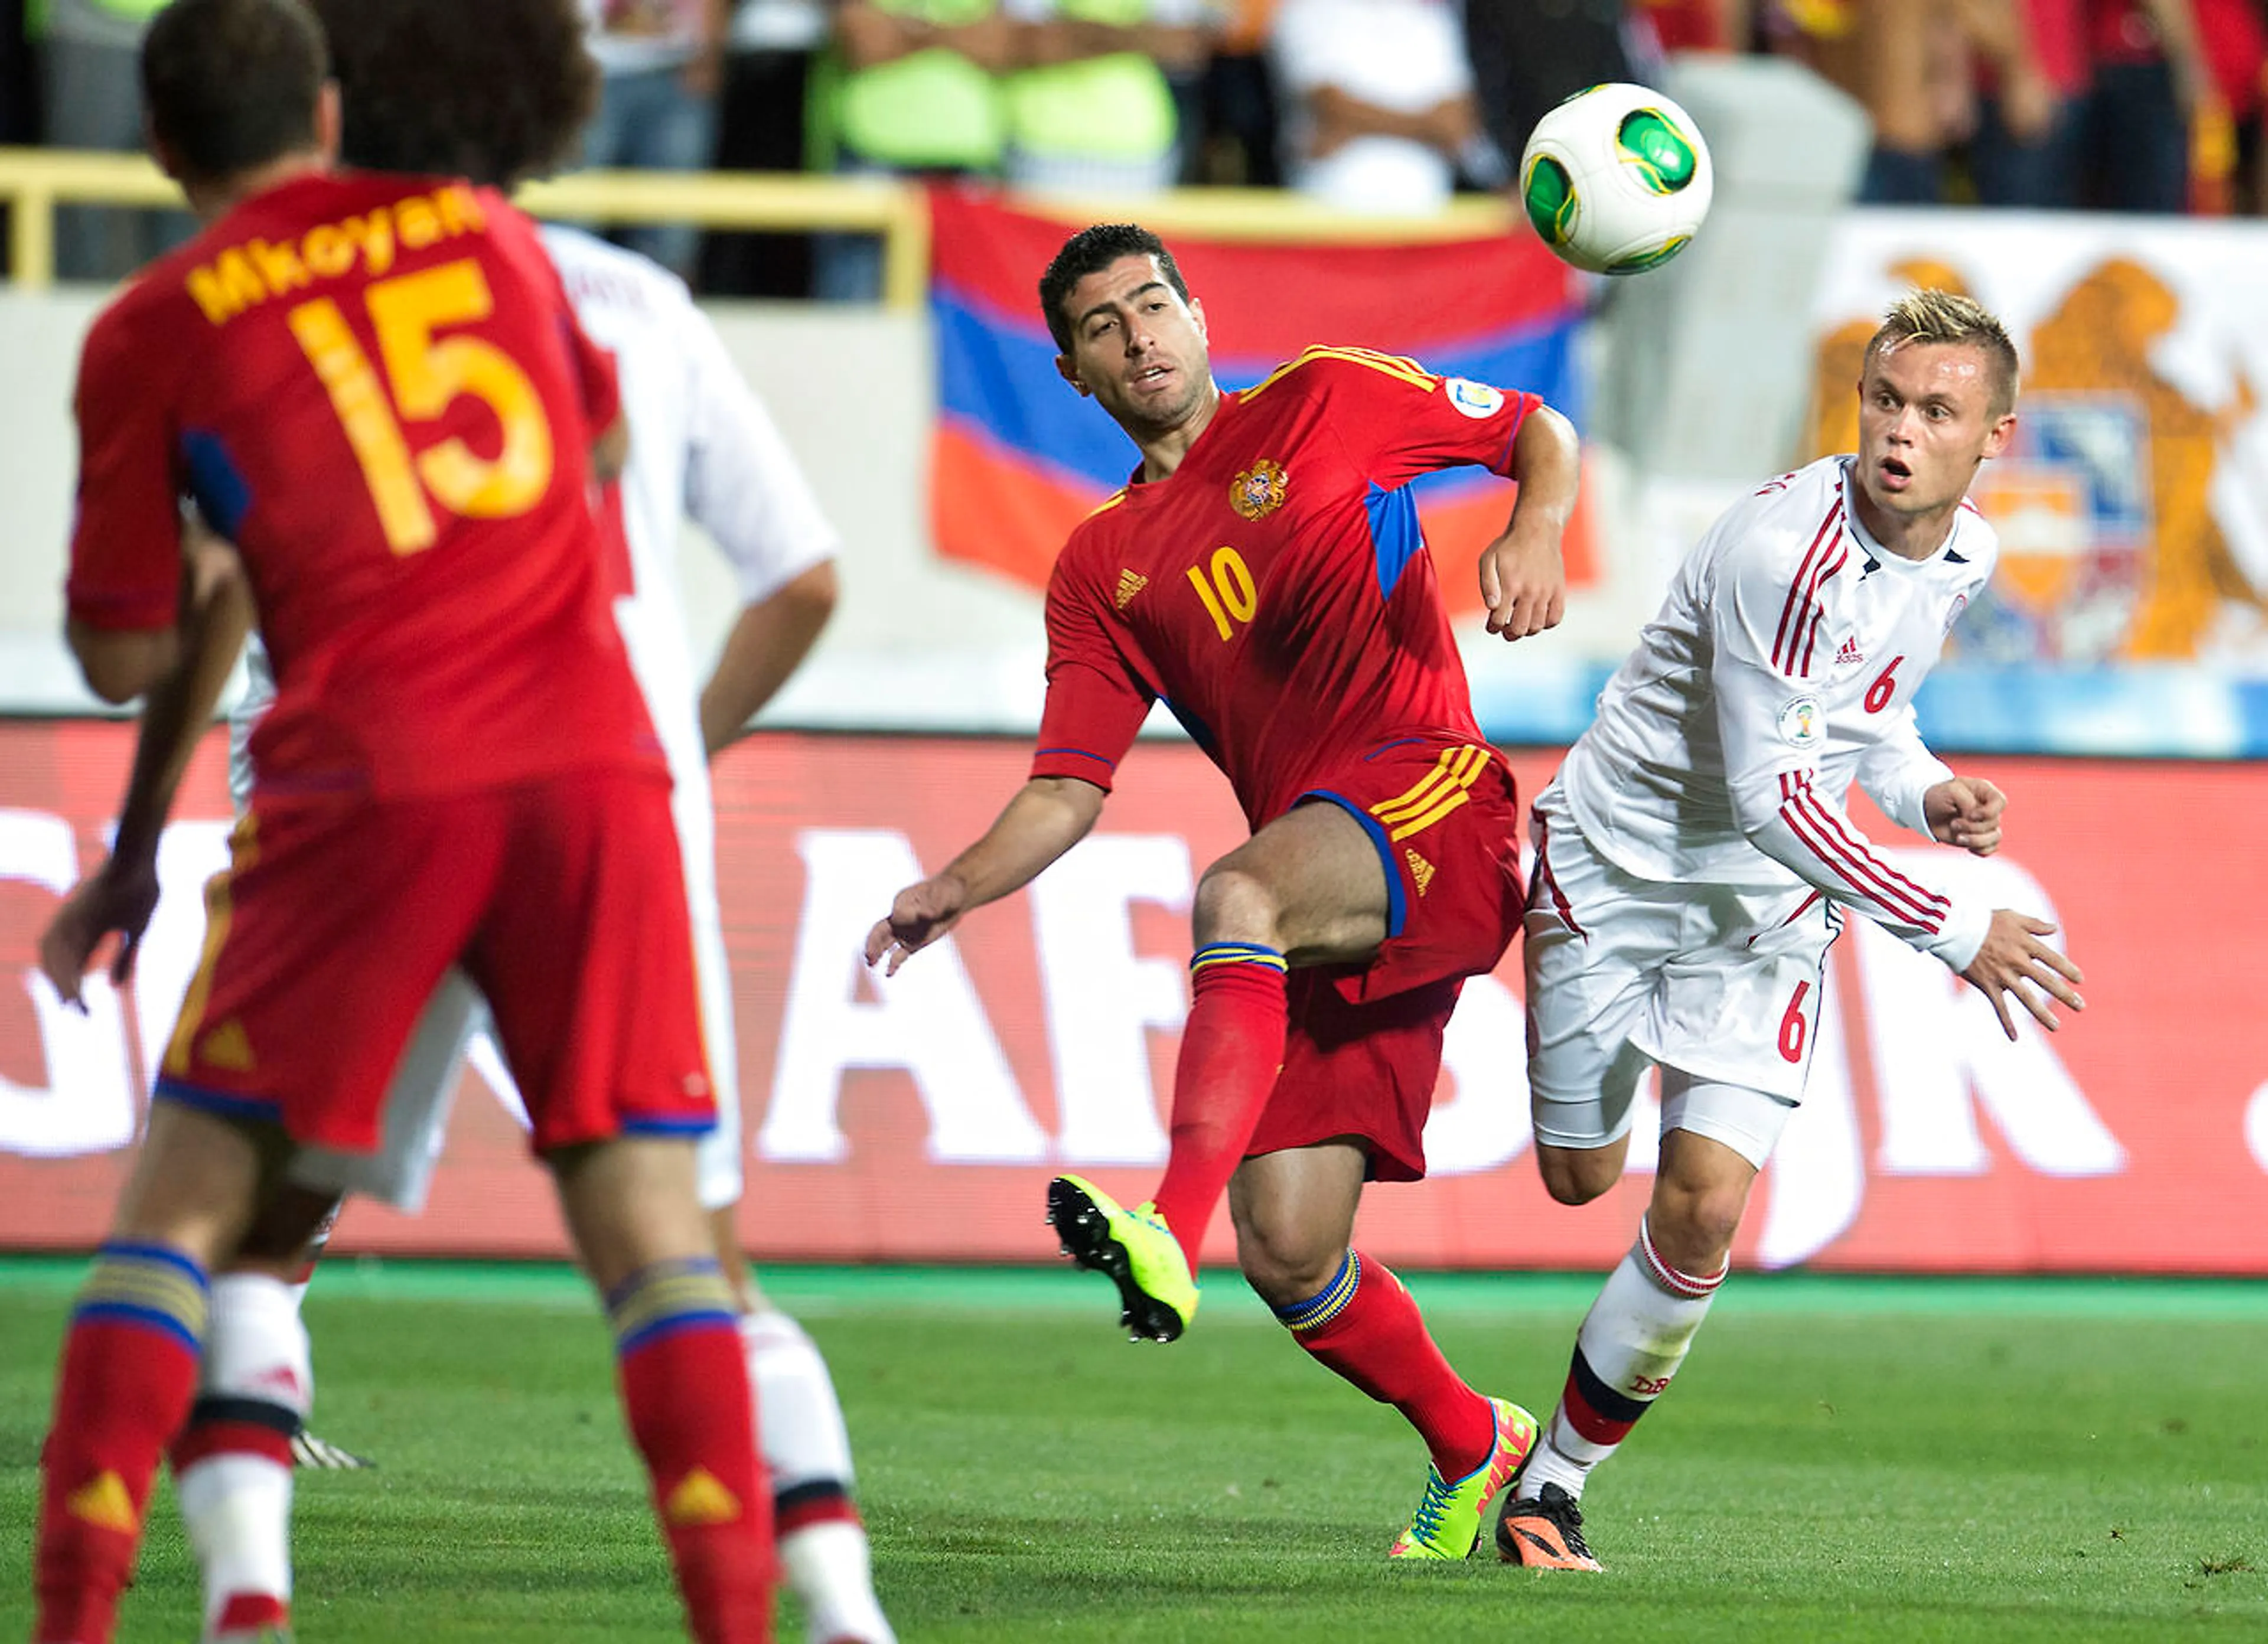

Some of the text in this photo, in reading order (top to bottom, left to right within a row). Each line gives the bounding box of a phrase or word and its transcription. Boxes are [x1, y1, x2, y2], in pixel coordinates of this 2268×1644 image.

[187, 184, 485, 325] Mkoyan
[288, 257, 553, 556] 15
[1187, 546, 1257, 642] 10
[1864, 655, 1904, 714] 6
[1778, 980, 1810, 1064] 6
